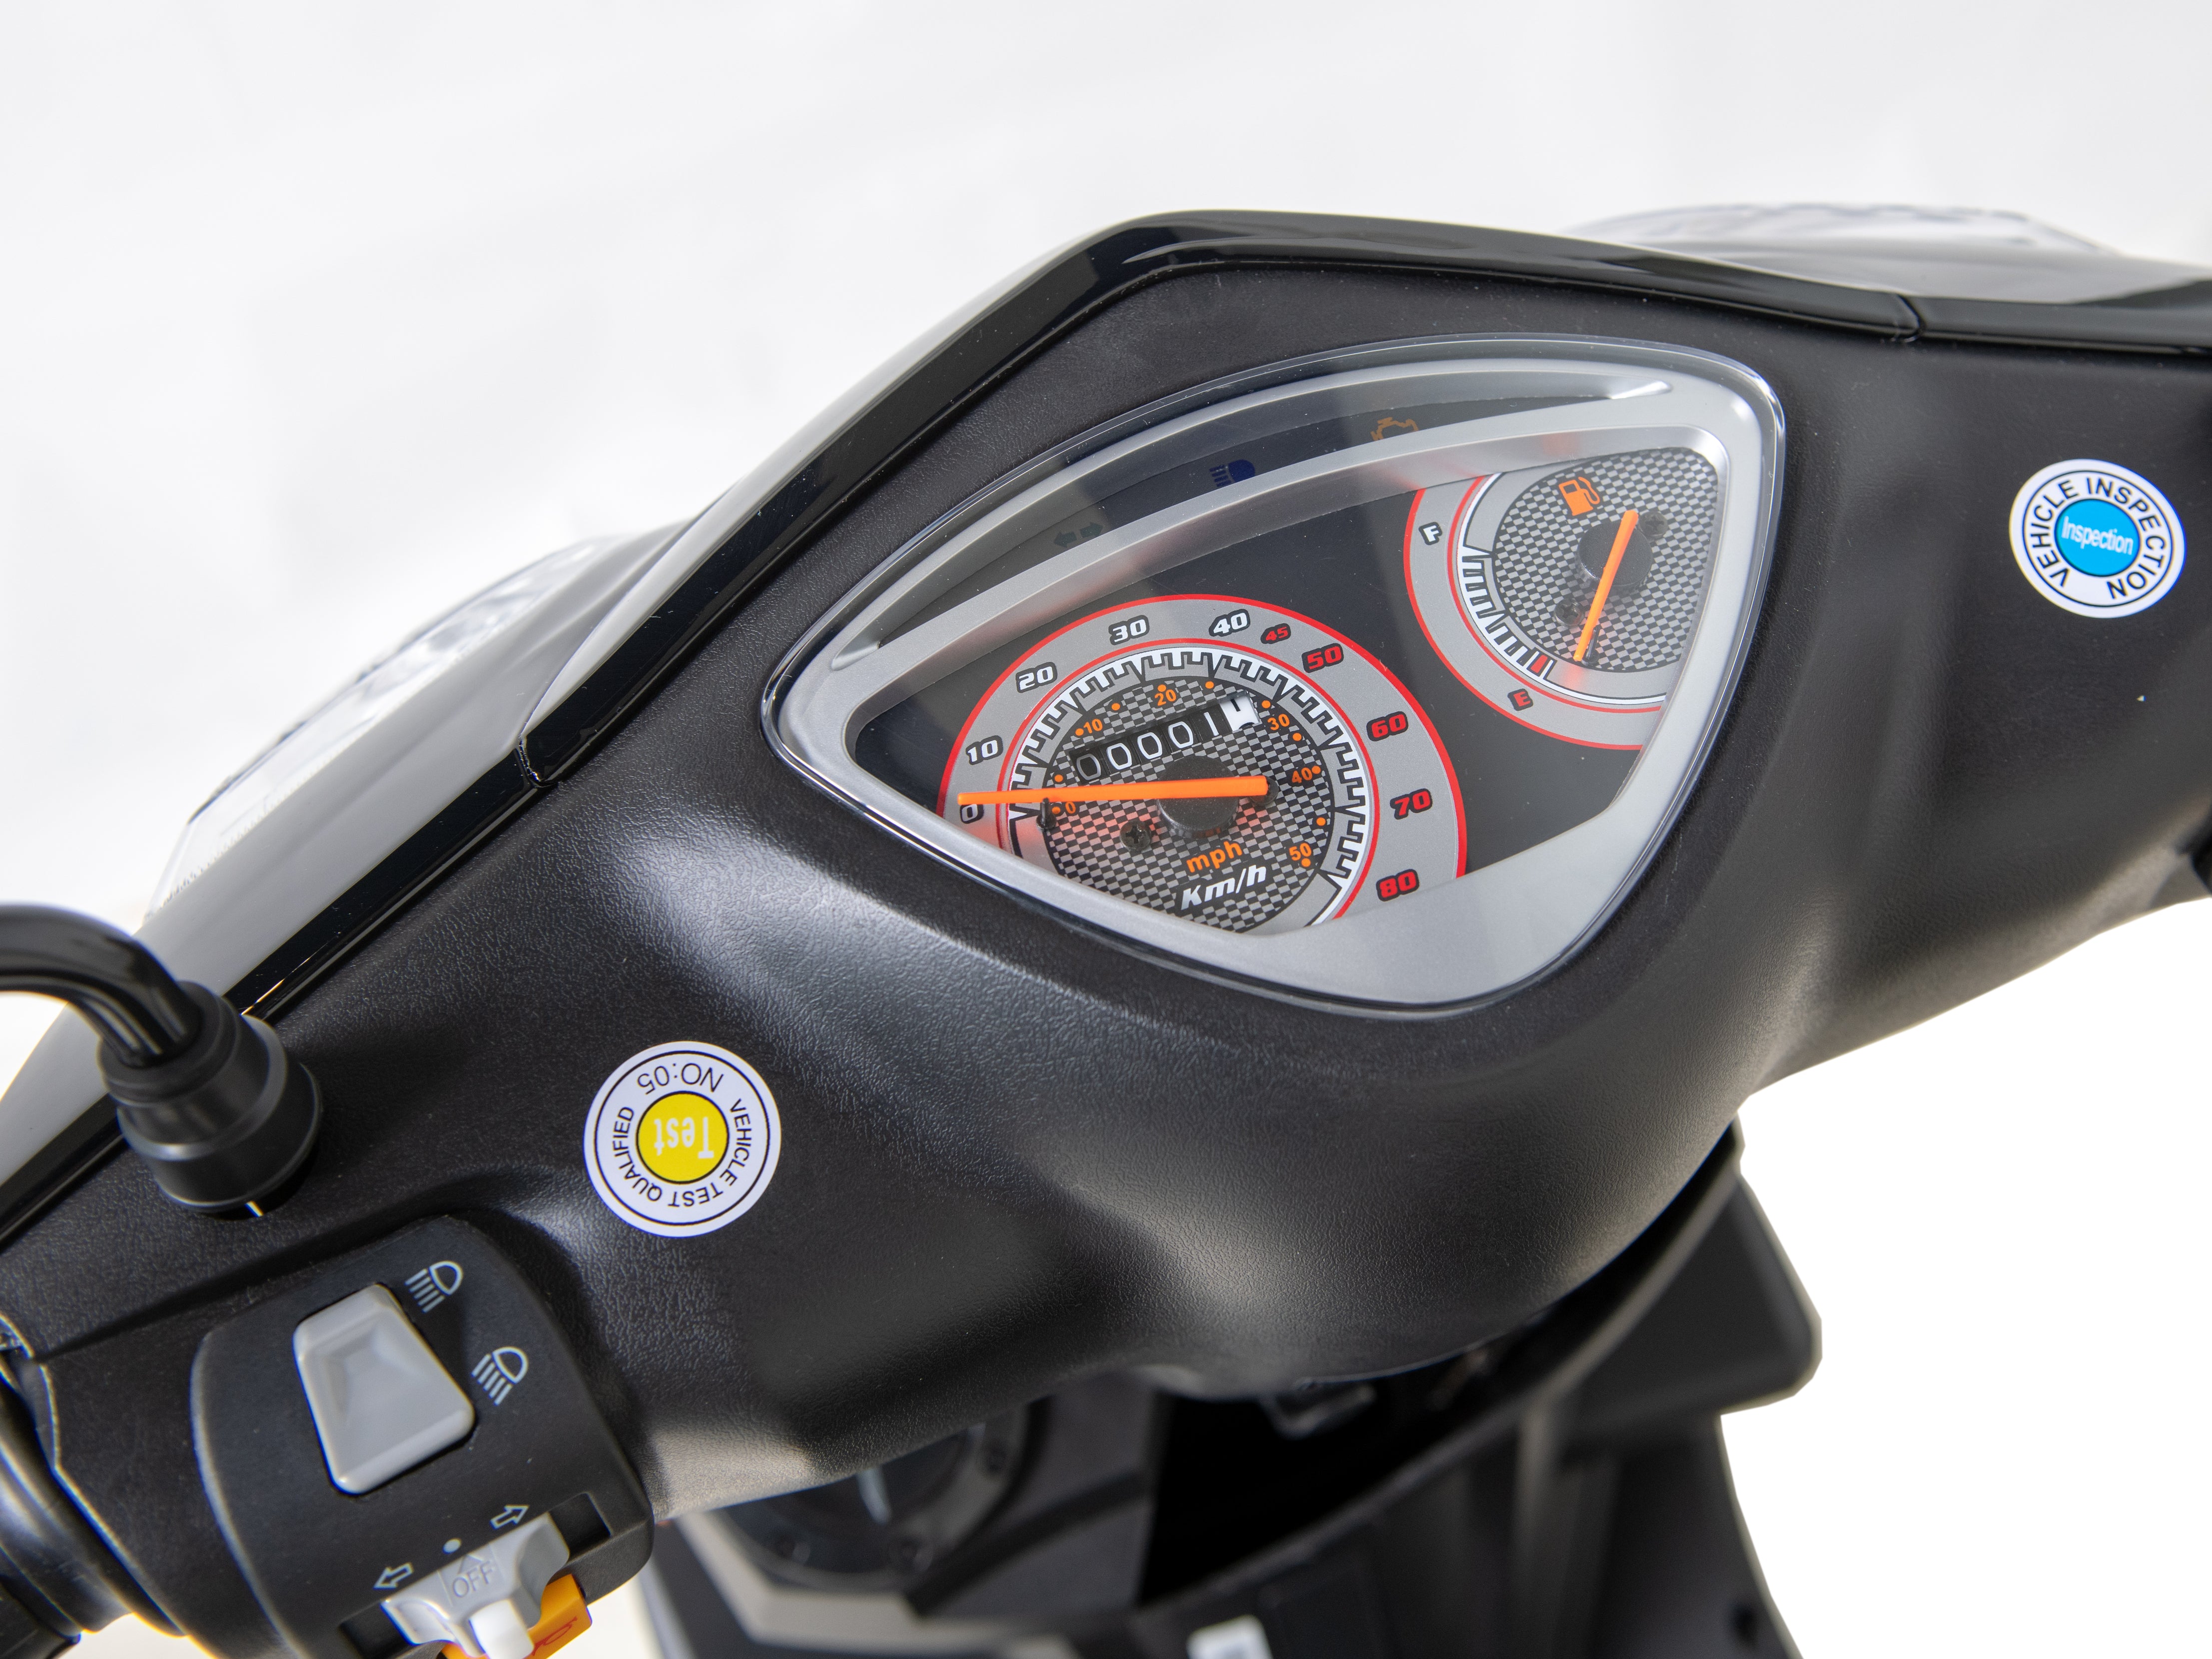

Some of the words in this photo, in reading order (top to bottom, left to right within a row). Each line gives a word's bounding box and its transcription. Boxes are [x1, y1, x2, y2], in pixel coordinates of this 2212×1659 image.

[1421, 524, 1441, 543] F
[2030, 480, 2080, 587] VEHICLE
[2086, 477, 2167, 600] INSPECTION
[2061, 515, 2134, 555] Inspection
[1111, 617, 1148, 643] 30
[1213, 611, 1248, 635] 40
[1264, 625, 1290, 643] 45
[1306, 645, 1343, 670] 50
[1018, 665, 1055, 691] 20
[1154, 689, 1177, 706] 20
[1512, 690, 1531, 707] E
[1083, 718, 1103, 734] 10
[1267, 713, 1290, 731] 30
[1370, 713, 1408, 738] 60
[966, 738, 1000, 763] 10
[1291, 767, 1313, 784] 40
[960, 804, 979, 822] 0
[1393, 790, 1432, 816] 70
[1186, 841, 1243, 873] mph
[1289, 843, 1312, 861] 50
[1379, 871, 1418, 899] 80
[637, 1063, 724, 1095] NO:05
[653, 1116, 715, 1159] Test
[719, 1098, 752, 1186] VEHICLE
[612, 1106, 663, 1201] QUALIFIED
[667, 1182, 724, 1207] TEST
[452, 1560, 494, 1598] OFF
